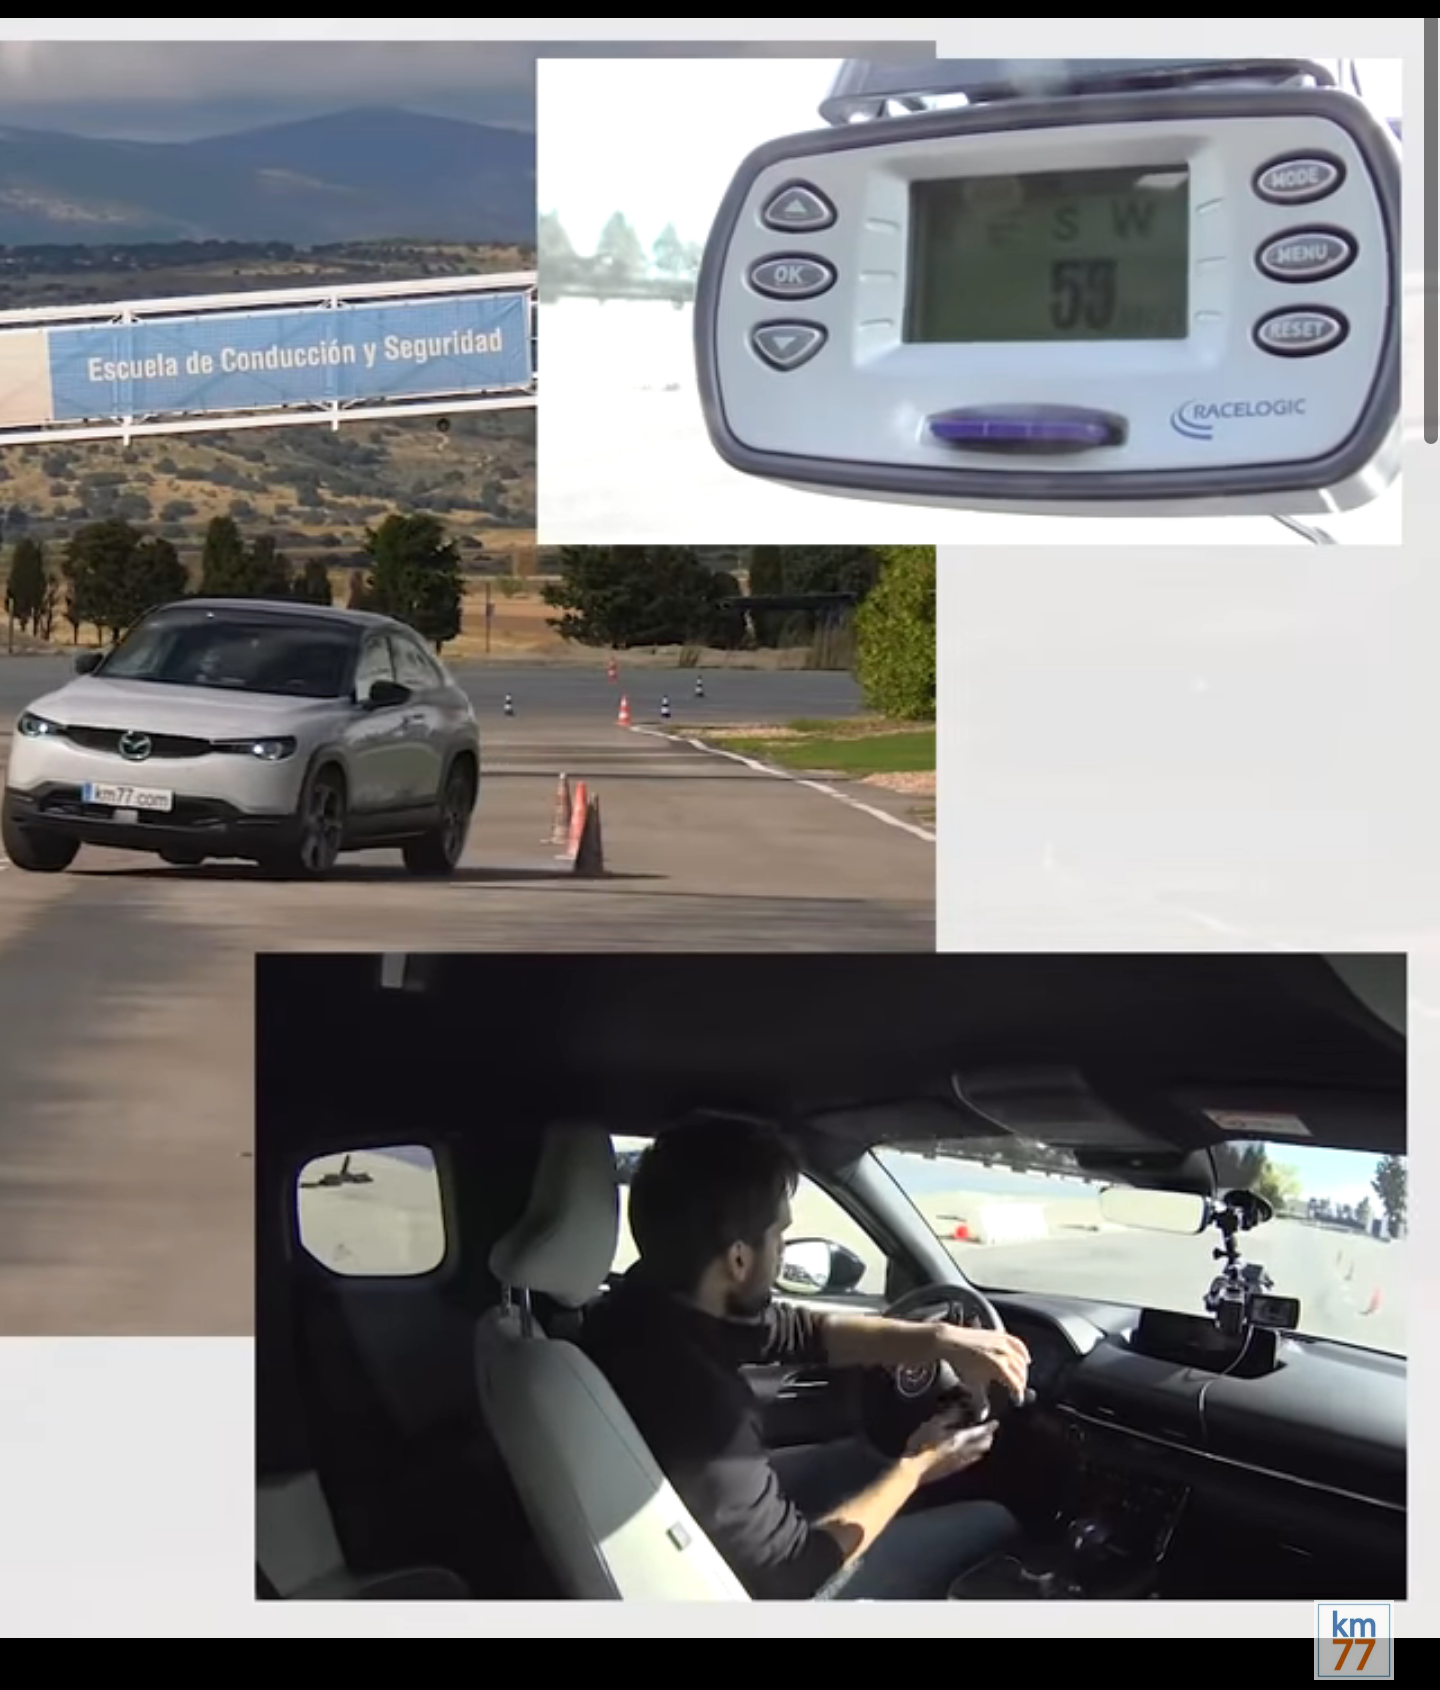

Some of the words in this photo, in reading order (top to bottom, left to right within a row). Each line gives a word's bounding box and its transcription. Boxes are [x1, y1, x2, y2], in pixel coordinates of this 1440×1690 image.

[1271, 166, 1320, 188] MODE
[1277, 243, 1329, 264] MENU
[774, 264, 804, 284] OK
[1269, 320, 1324, 338] RESET
[87, 353, 179, 382] Escuela
[186, 351, 214, 375] de
[220, 337, 356, 372] Conducción
[363, 341, 378, 368] y
[383, 327, 503, 364] Seguridad
[1193, 399, 1307, 420] RACELOGIC
